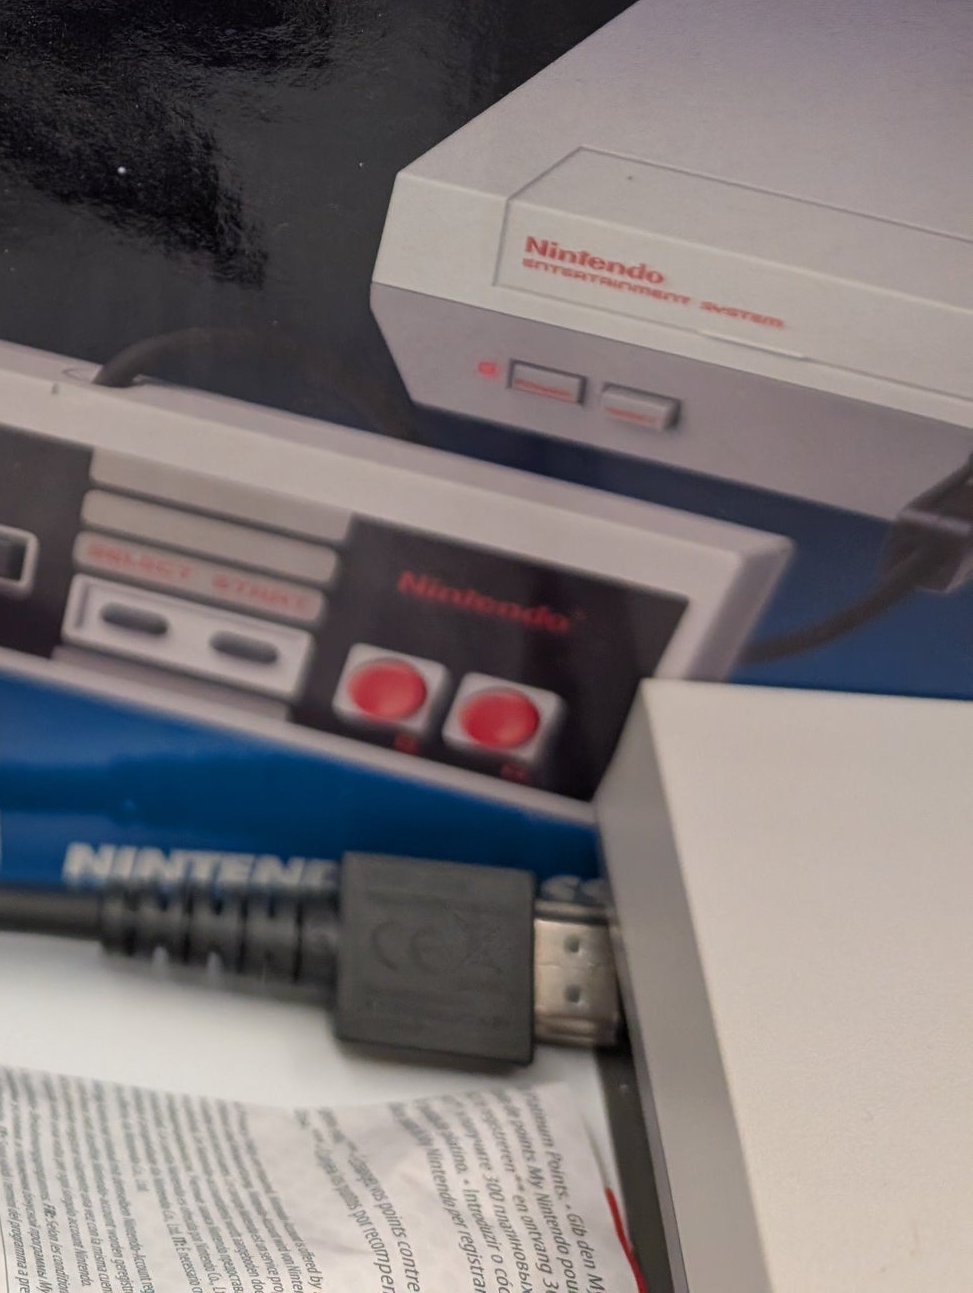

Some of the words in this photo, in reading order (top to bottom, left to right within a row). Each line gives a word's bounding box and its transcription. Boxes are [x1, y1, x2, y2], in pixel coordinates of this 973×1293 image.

[524, 235, 665, 285] Nintendo
[522, 258, 691, 306] ENTERTAINMENT
[699, 300, 785, 329] SYSTEM
[397, 571, 571, 634] Nintendo
[483, 1175, 505, 1202] 300
[526, 1166, 545, 1189] My
[512, 1195, 529, 1212] en
[45, 1218, 60, 1241] Selon
[348, 1210, 374, 1227] por
[443, 1208, 469, 1228] per
[463, 1189, 502, 1251] Introduzir
[491, 1254, 504, 1264] o
[535, 1194, 571, 1254] Nintendo
[567, 1214, 588, 1236] Gib
[7, 1220, 28, 1269] programma
[27, 1228, 48, 1279] программы
[49, 1242, 63, 1255] les
[107, 1229, 125, 1257] worden
[124, 1218, 151, 1281] Nintendo-Account
[172, 1237, 188, 1247] IT:
[374, 1203, 407, 1238] points
[397, 1241, 421, 1292] contre
[520, 1216, 553, 1274] ontvang
[577, 1240, 595, 1269] den
[75, 1249, 94, 1287] Nintendo.
[92, 1246, 109, 1272] misma
[178, 1252, 202, 1286] necessario
[196, 1243, 217, 1271] Nintendo
[298, 1249, 323, 1274] offered
[267, 1276, 284, 1293] pro
[307, 1276, 324, 1290] by
